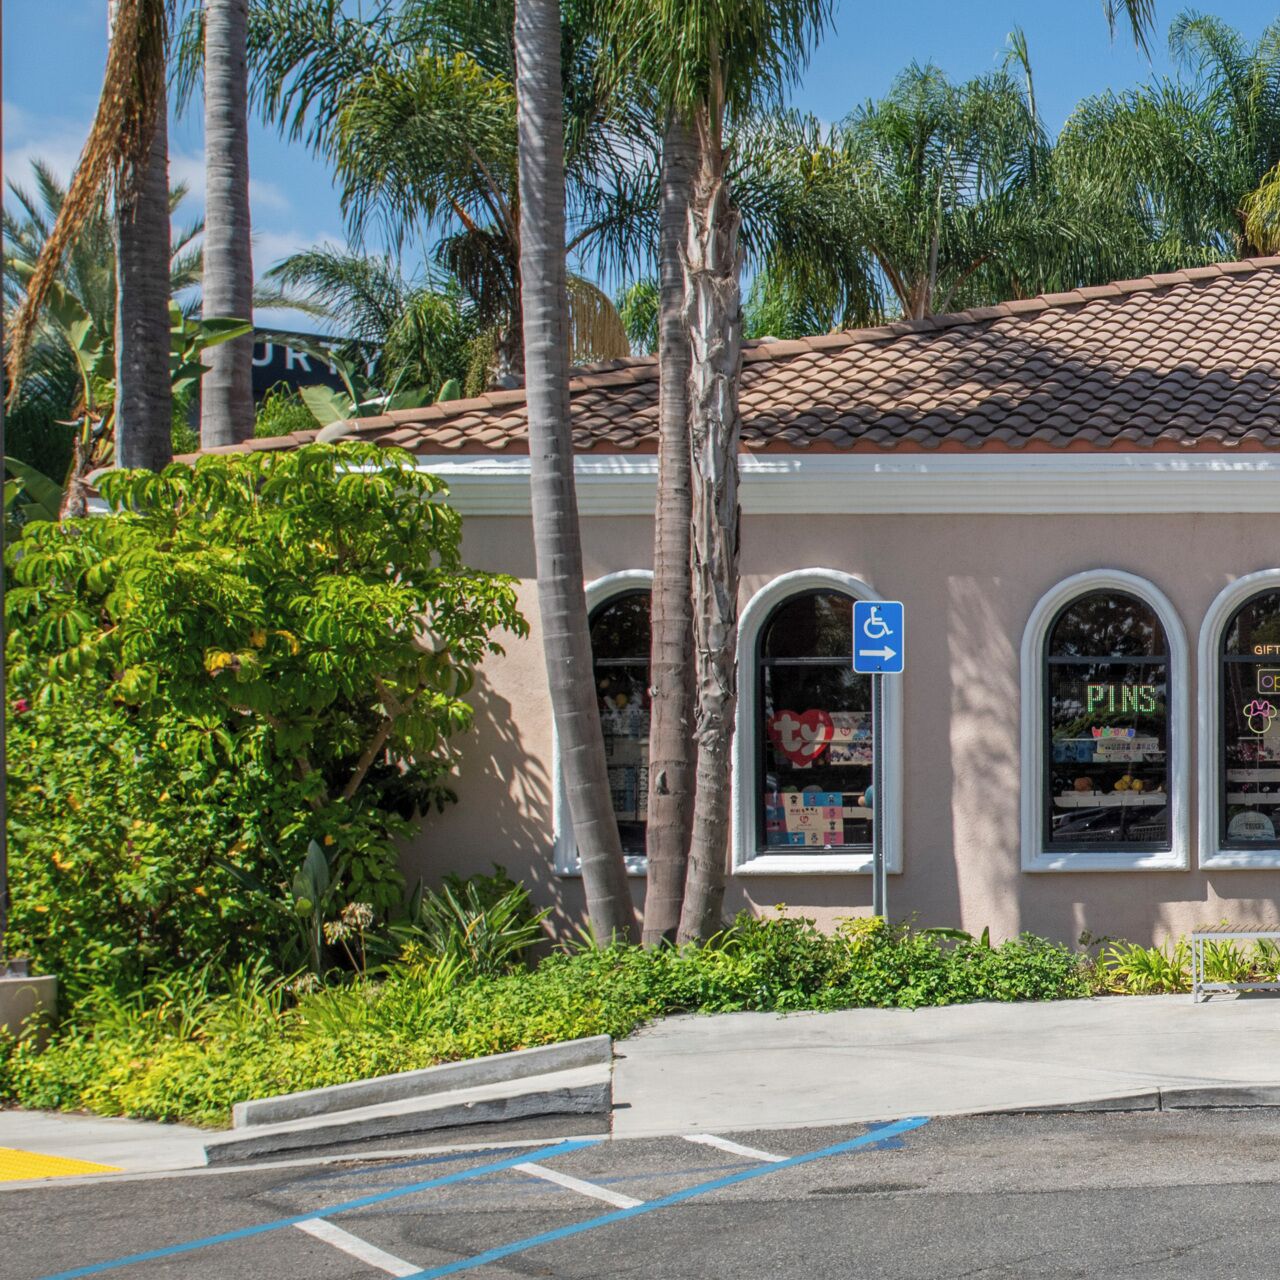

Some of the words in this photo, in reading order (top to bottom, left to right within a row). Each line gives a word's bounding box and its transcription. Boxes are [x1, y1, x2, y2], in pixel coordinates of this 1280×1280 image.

[1254, 645, 1280, 655] GIFT
[1088, 684, 1155, 712] PINS
[773, 714, 826, 756] ty
